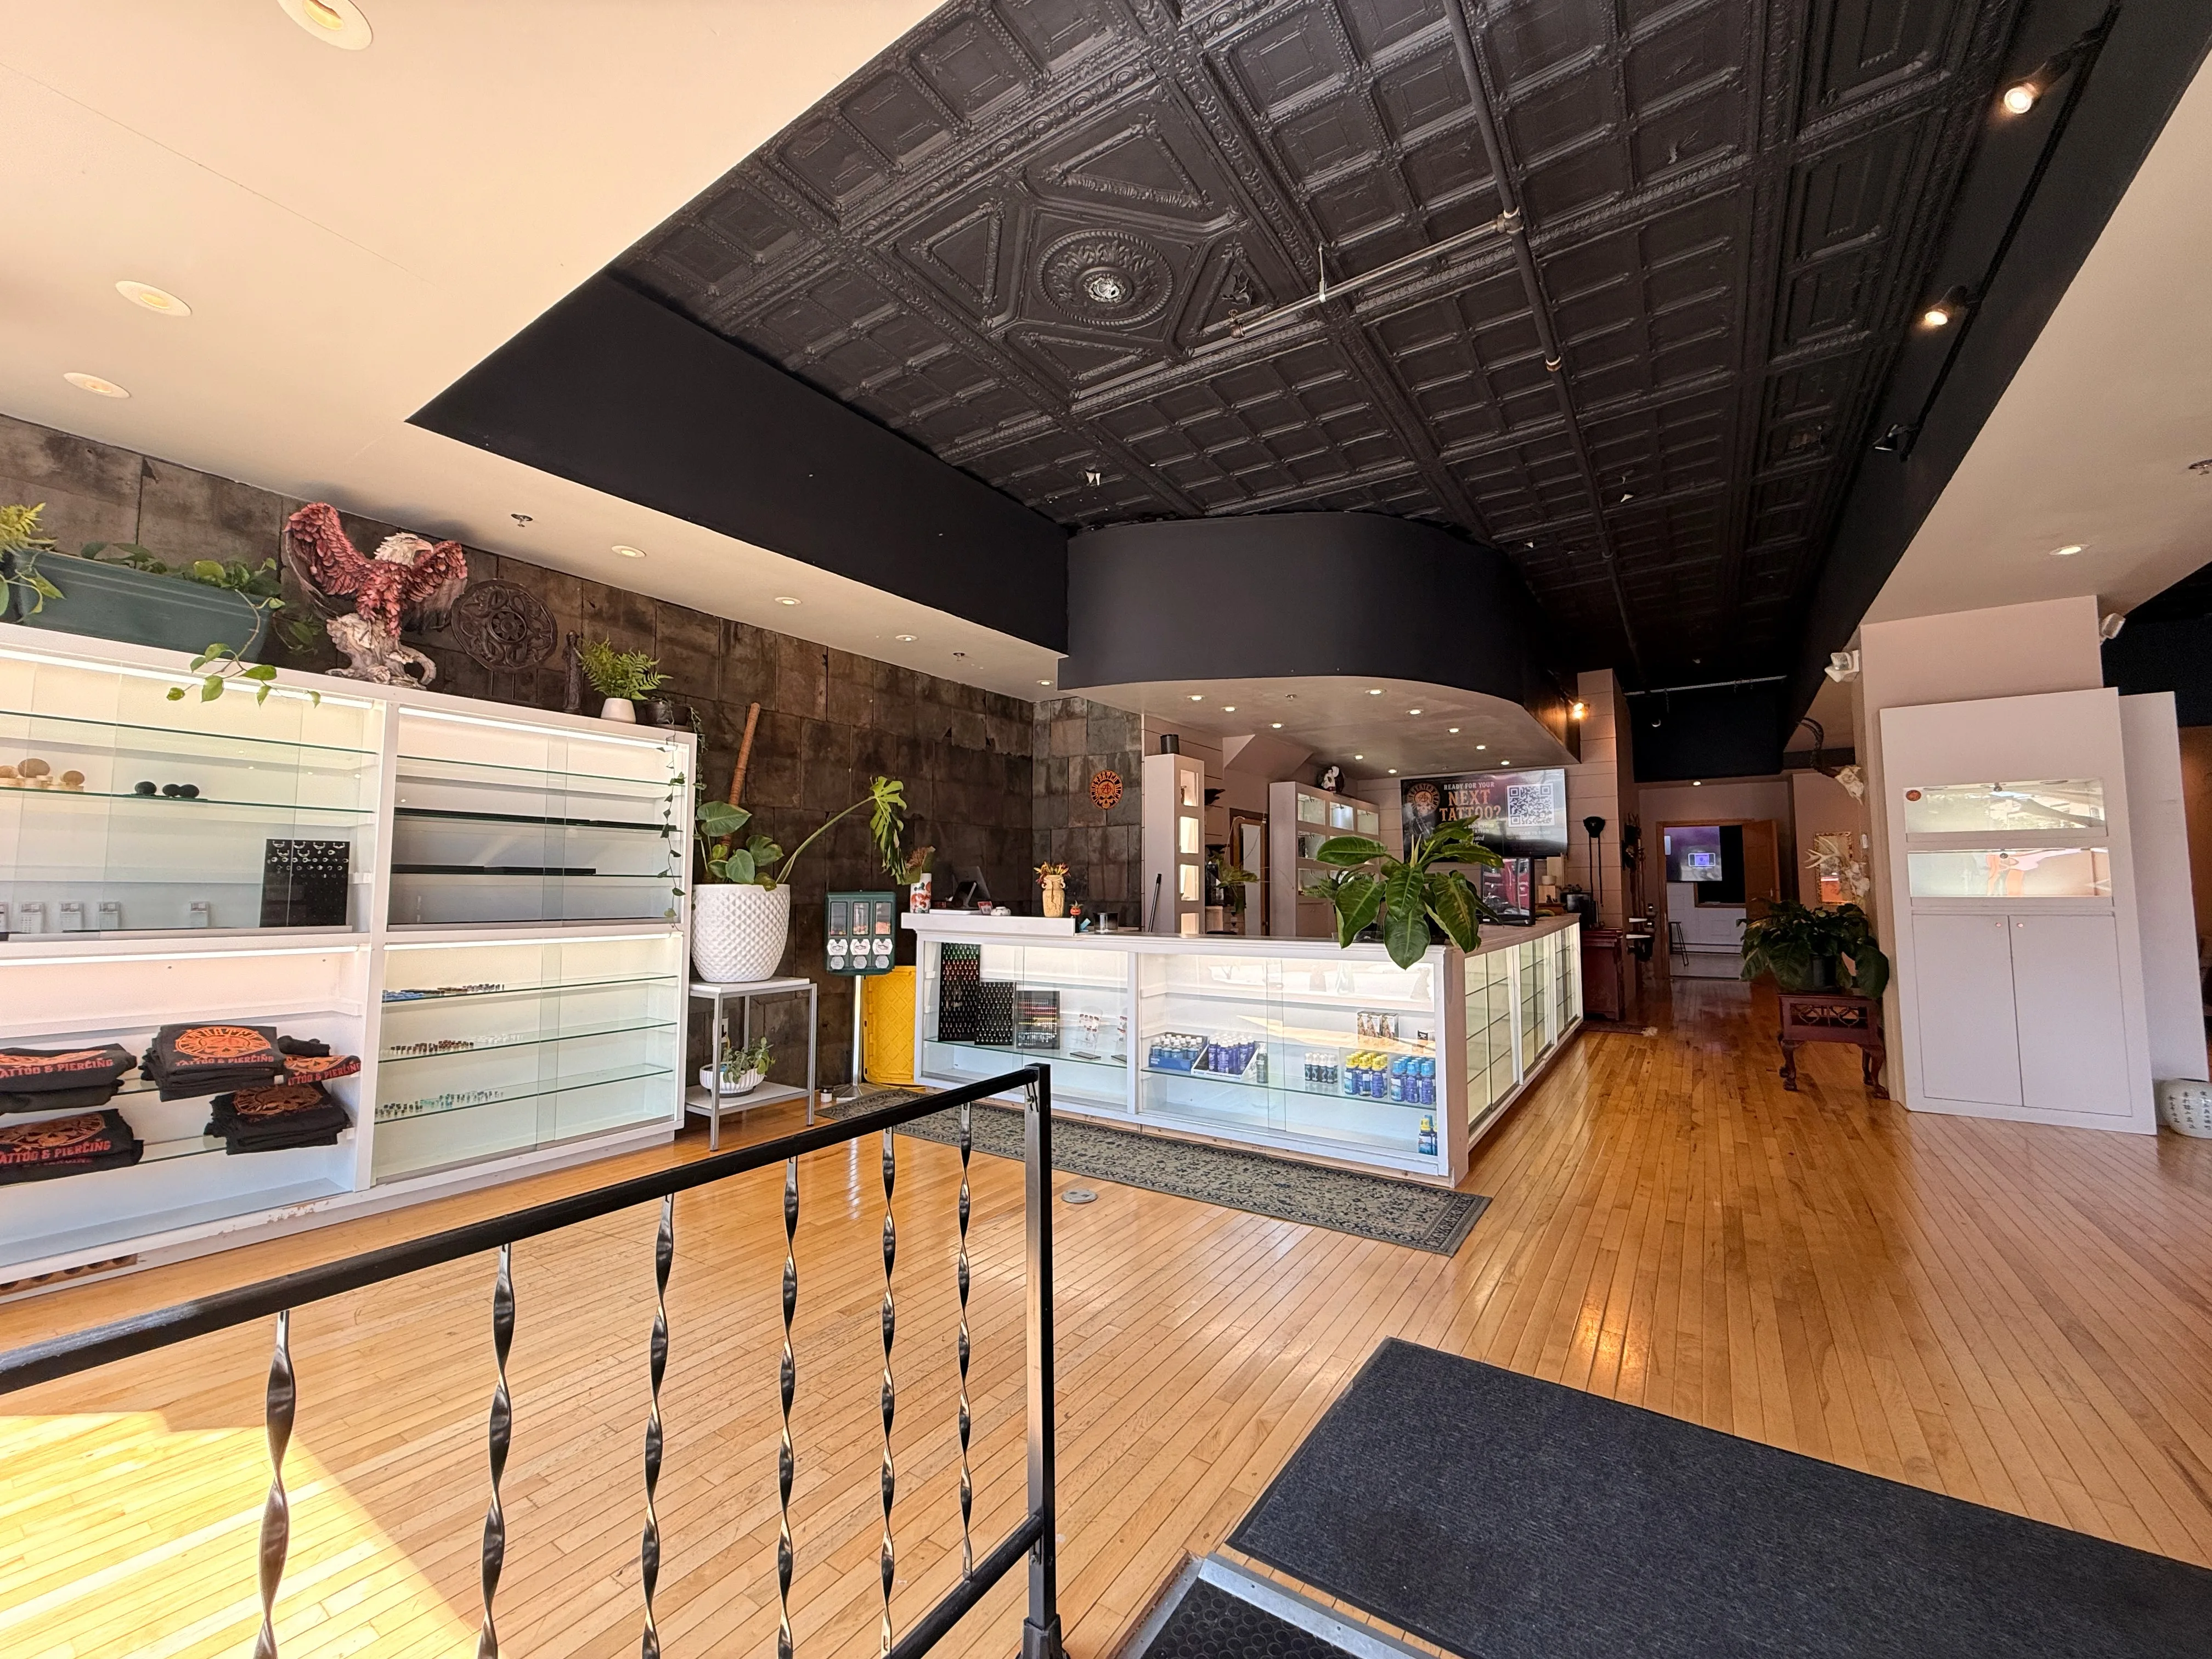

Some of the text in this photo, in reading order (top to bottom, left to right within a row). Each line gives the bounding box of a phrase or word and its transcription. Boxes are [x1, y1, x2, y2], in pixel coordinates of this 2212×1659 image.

[1448, 789, 1490, 806] NEXT
[1439, 805, 1501, 821] TATTOO?
[0, 1066, 40, 1078] ATTOO
[0, 1150, 38, 1164] ATTOO
[41, 1149, 50, 1160] &
